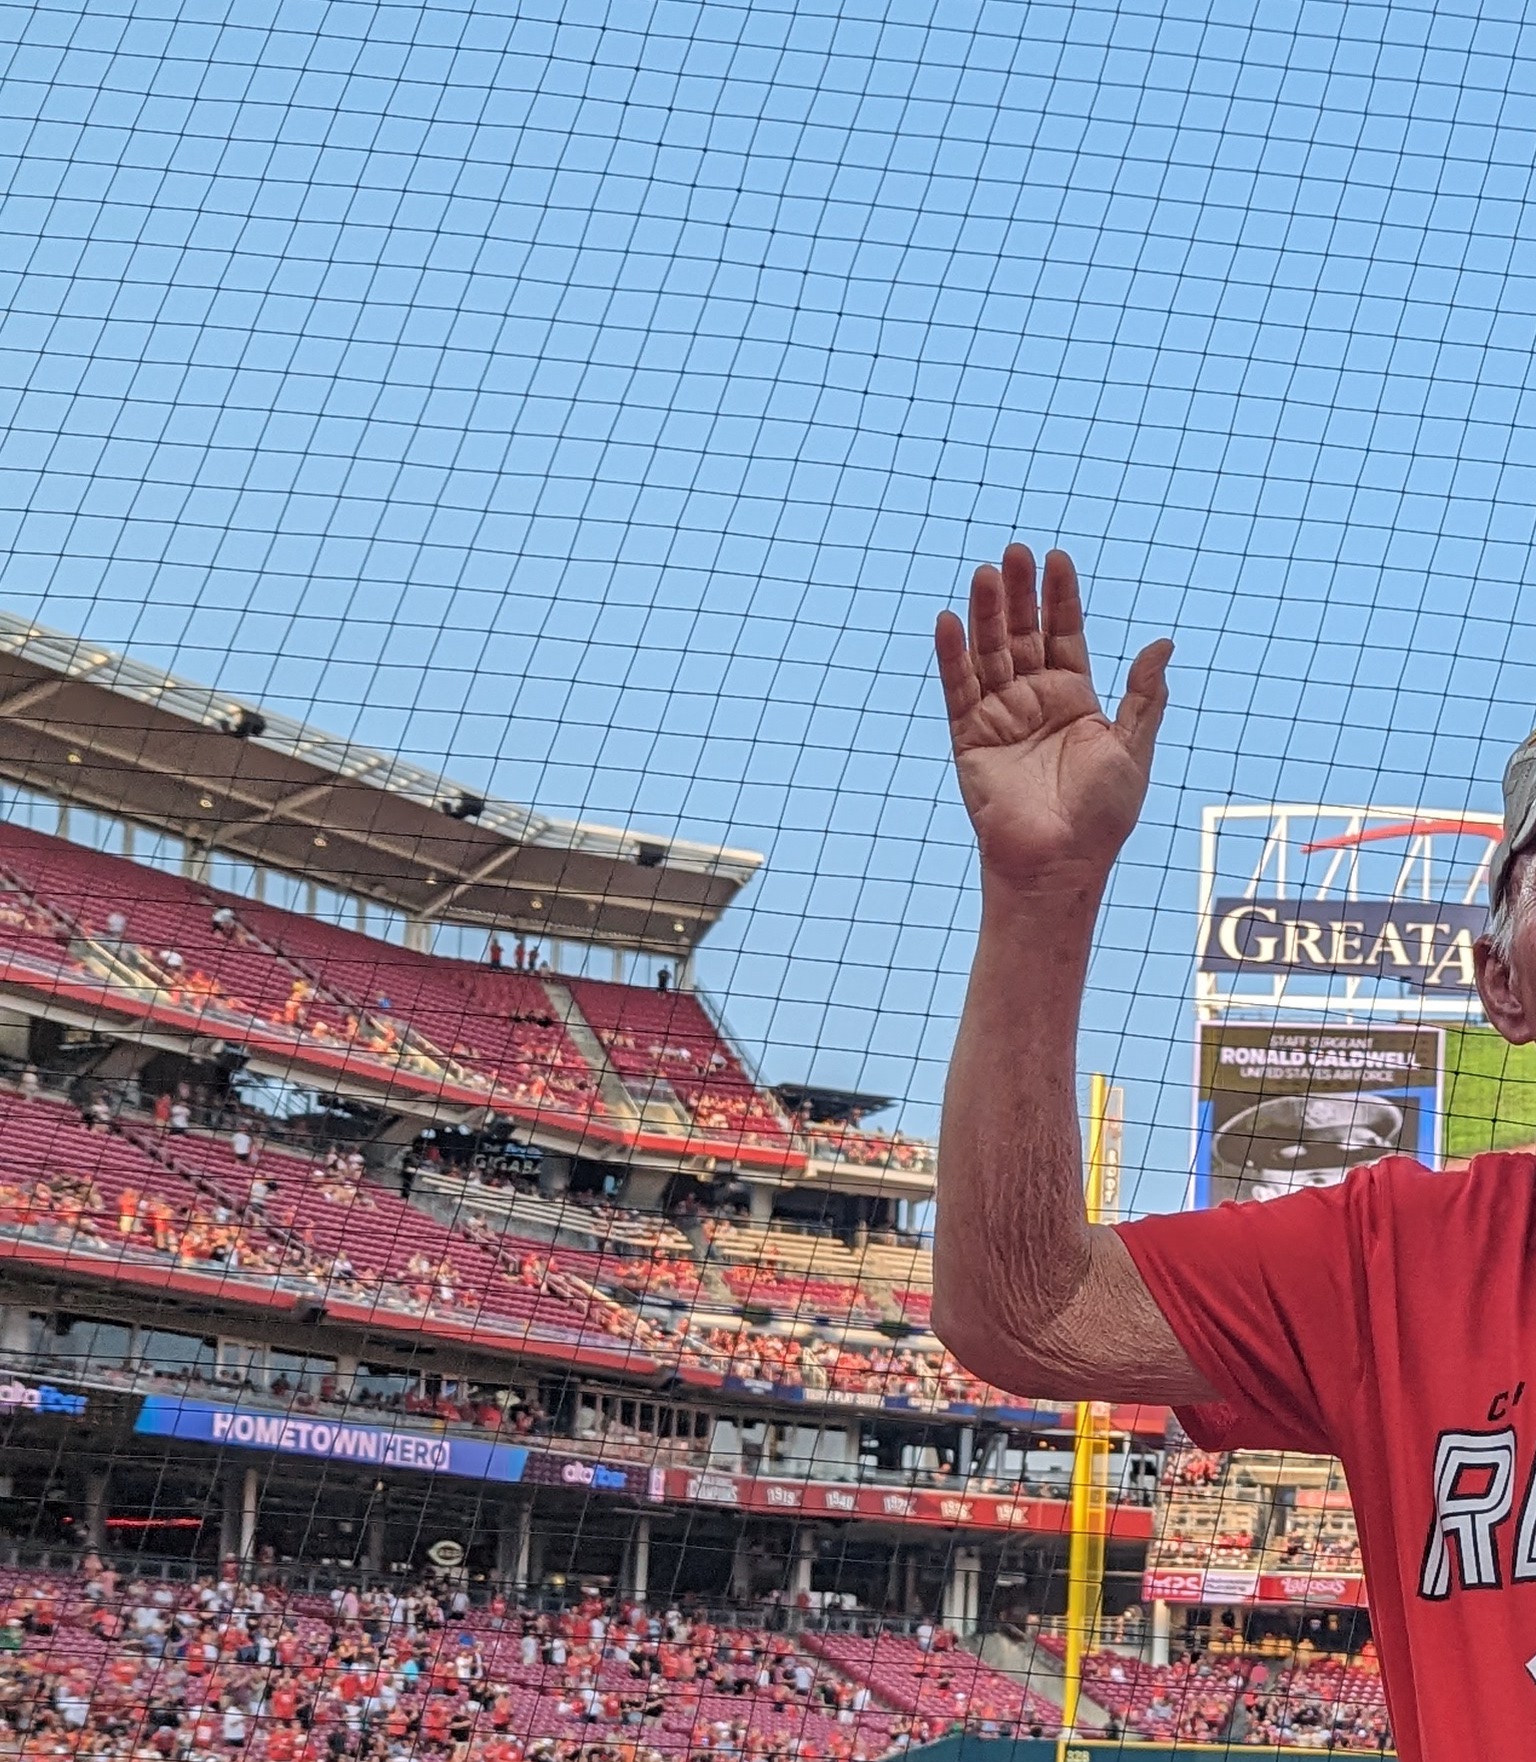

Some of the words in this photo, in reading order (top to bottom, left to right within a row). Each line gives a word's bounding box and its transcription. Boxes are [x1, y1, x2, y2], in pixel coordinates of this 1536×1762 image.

[1270, 1034, 1307, 1050] STAFF
[1310, 1036, 1374, 1051] SERGEANT
[1219, 1047, 1308, 1067] RONALD
[1309, 1050, 1422, 1069] CALDWELL
[1355, 1069, 1394, 1082] FORCE
[212, 1411, 378, 1460] HOMETOWN
[380, 1433, 448, 1468] HERO
